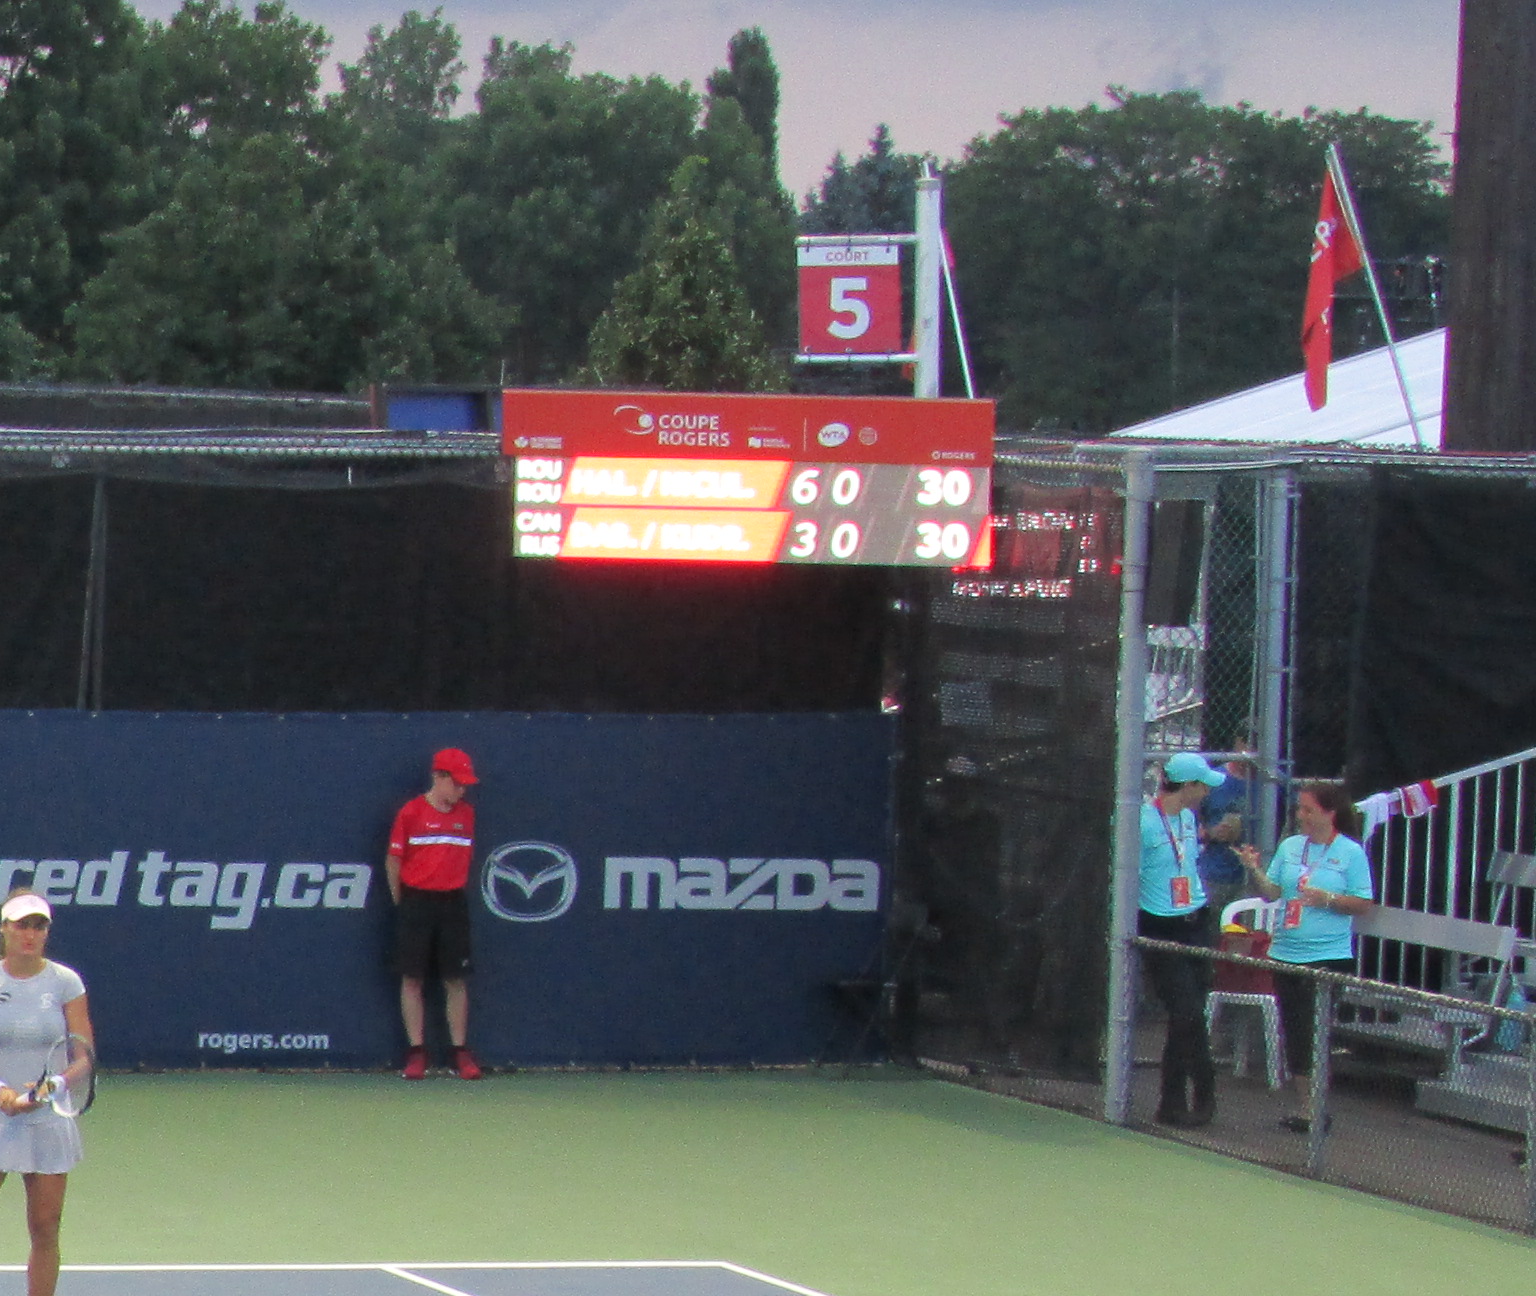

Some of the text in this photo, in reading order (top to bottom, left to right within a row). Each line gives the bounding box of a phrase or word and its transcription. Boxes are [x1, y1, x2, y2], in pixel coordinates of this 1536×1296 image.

[826, 251, 869, 262] COURT
[828, 277, 871, 340] 5
[658, 414, 720, 430] COUPE
[658, 431, 731, 447] ROGERS
[517, 458, 562, 480] ROU
[516, 482, 562, 503] ROU
[792, 469, 820, 506] 6
[832, 469, 861, 506] 0
[916, 469, 971, 507] 30
[516, 512, 561, 533] CAN
[788, 521, 819, 558] 3
[831, 522, 859, 559] 0
[915, 522, 970, 559] 30
[197, 1032, 330, 1054] rogers.com
